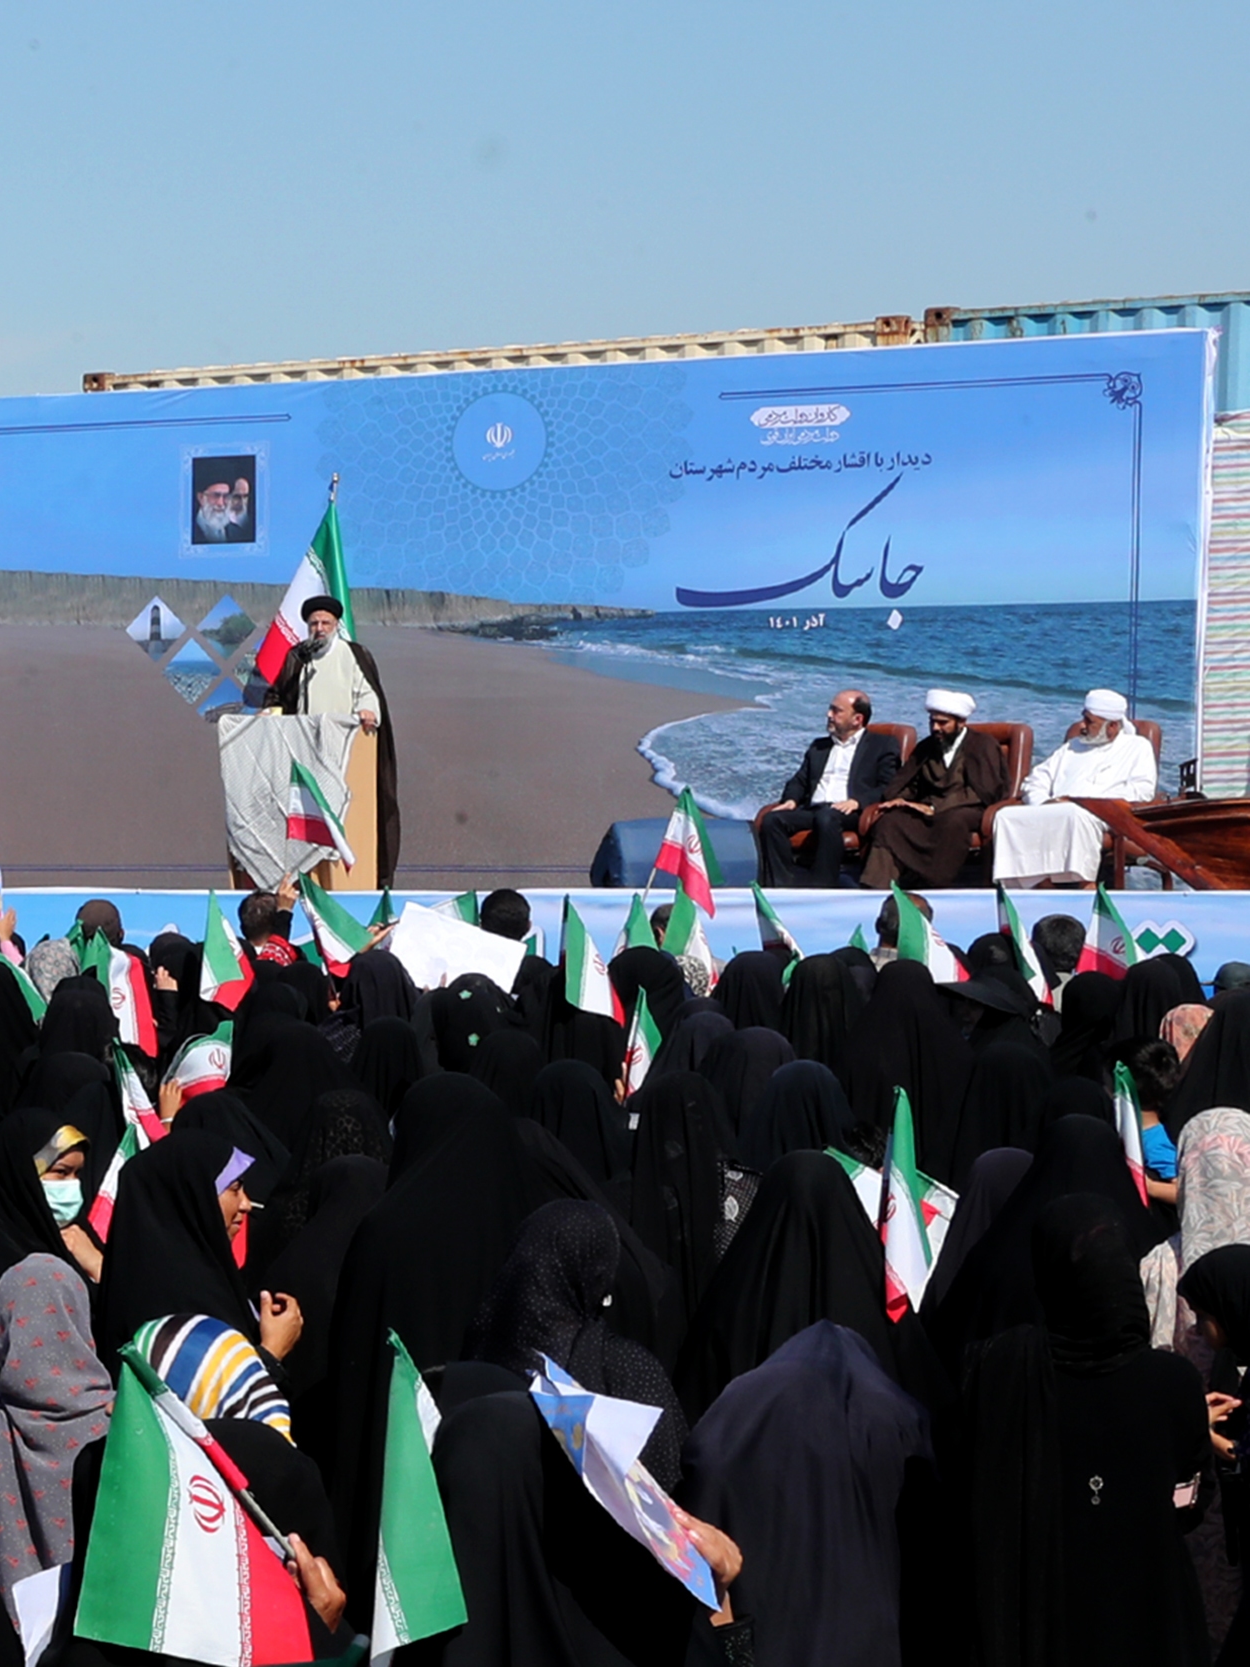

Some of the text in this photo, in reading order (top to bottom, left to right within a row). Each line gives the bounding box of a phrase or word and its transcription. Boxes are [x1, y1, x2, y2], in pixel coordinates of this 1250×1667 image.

[669, 451, 933, 482] دیدار با اقشار مختلف مردم شهرستان
[675, 471, 924, 630] جاسک
[803, 613, 826, 631] آذر
